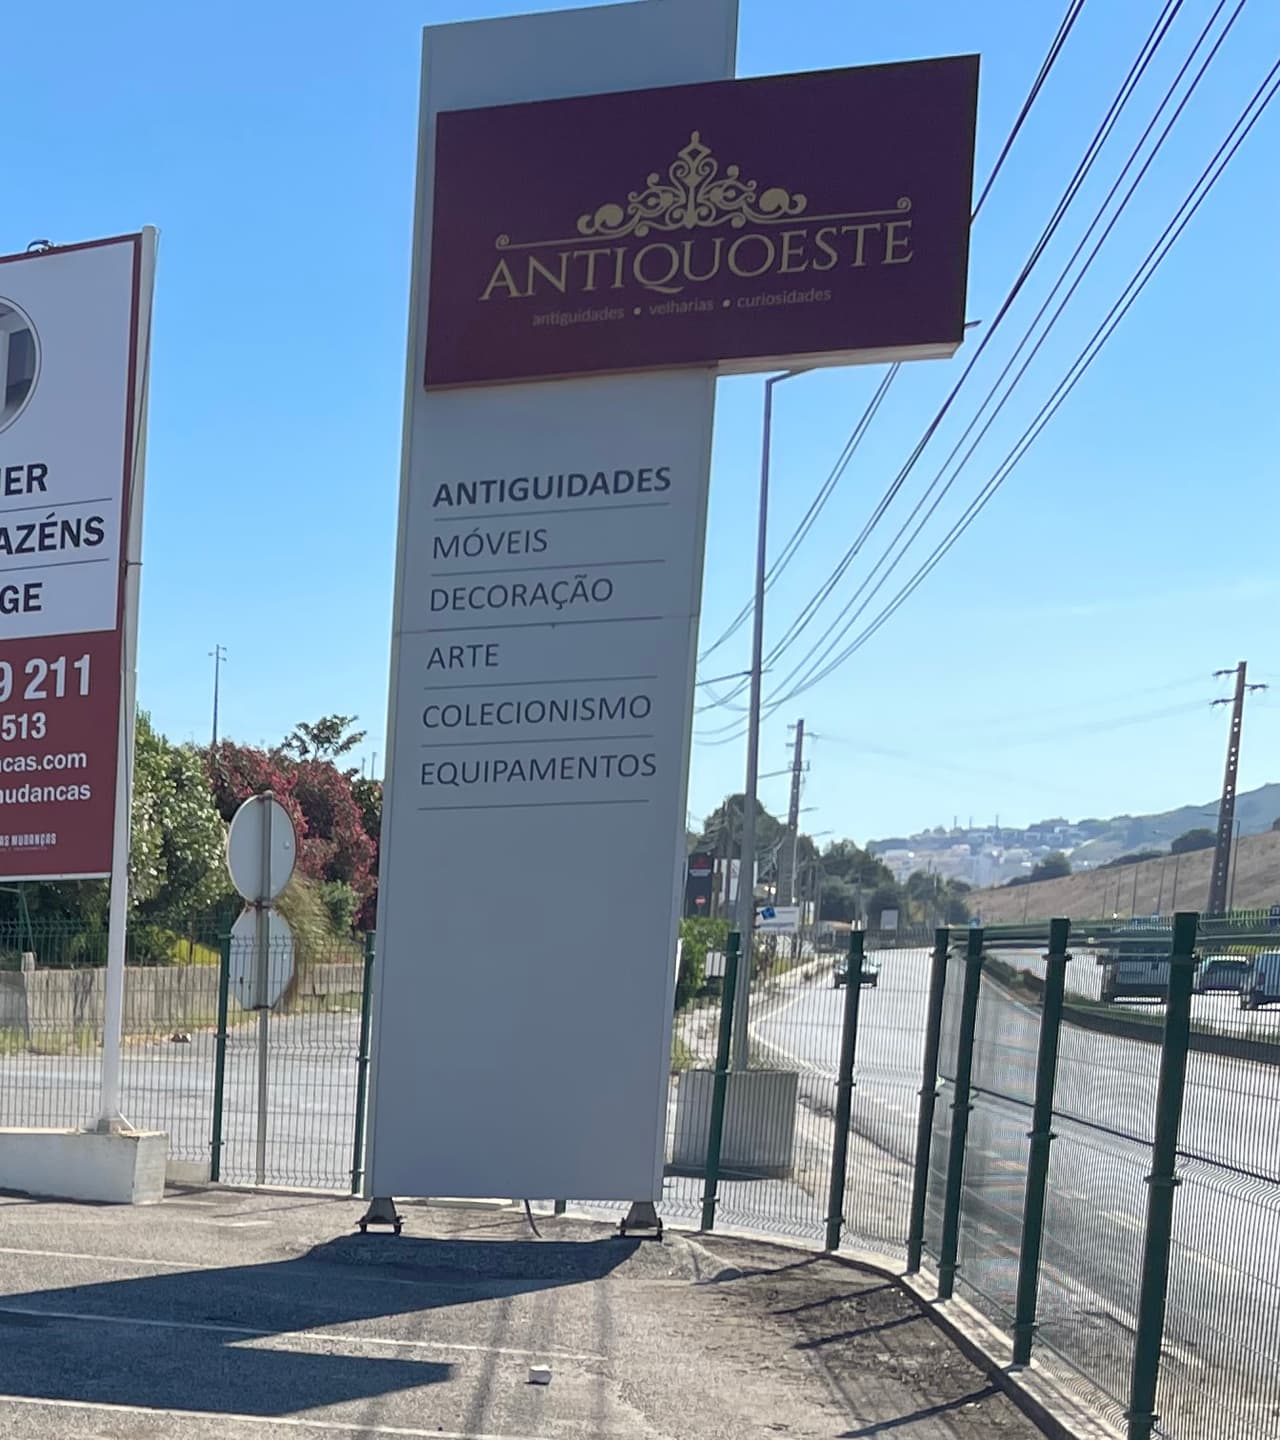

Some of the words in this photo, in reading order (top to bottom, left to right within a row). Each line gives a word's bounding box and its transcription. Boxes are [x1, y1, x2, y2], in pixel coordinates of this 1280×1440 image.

[478, 219, 915, 300] ANTIQUOESTE
[532, 307, 625, 327] antiguidades
[649, 298, 715, 316] velharias
[736, 288, 833, 308] curiosidades
[432, 467, 672, 507] ANTIGUIDADES
[433, 527, 549, 559] MÓVEIS
[429, 574, 613, 611] DECORAÇÃO
[426, 643, 500, 670] ARTE
[23, 654, 91, 700] 211
[1, 711, 47, 740] 513
[422, 695, 651, 728] COLECIONISMO
[421, 753, 657, 787] EQUIPAMENTOS
